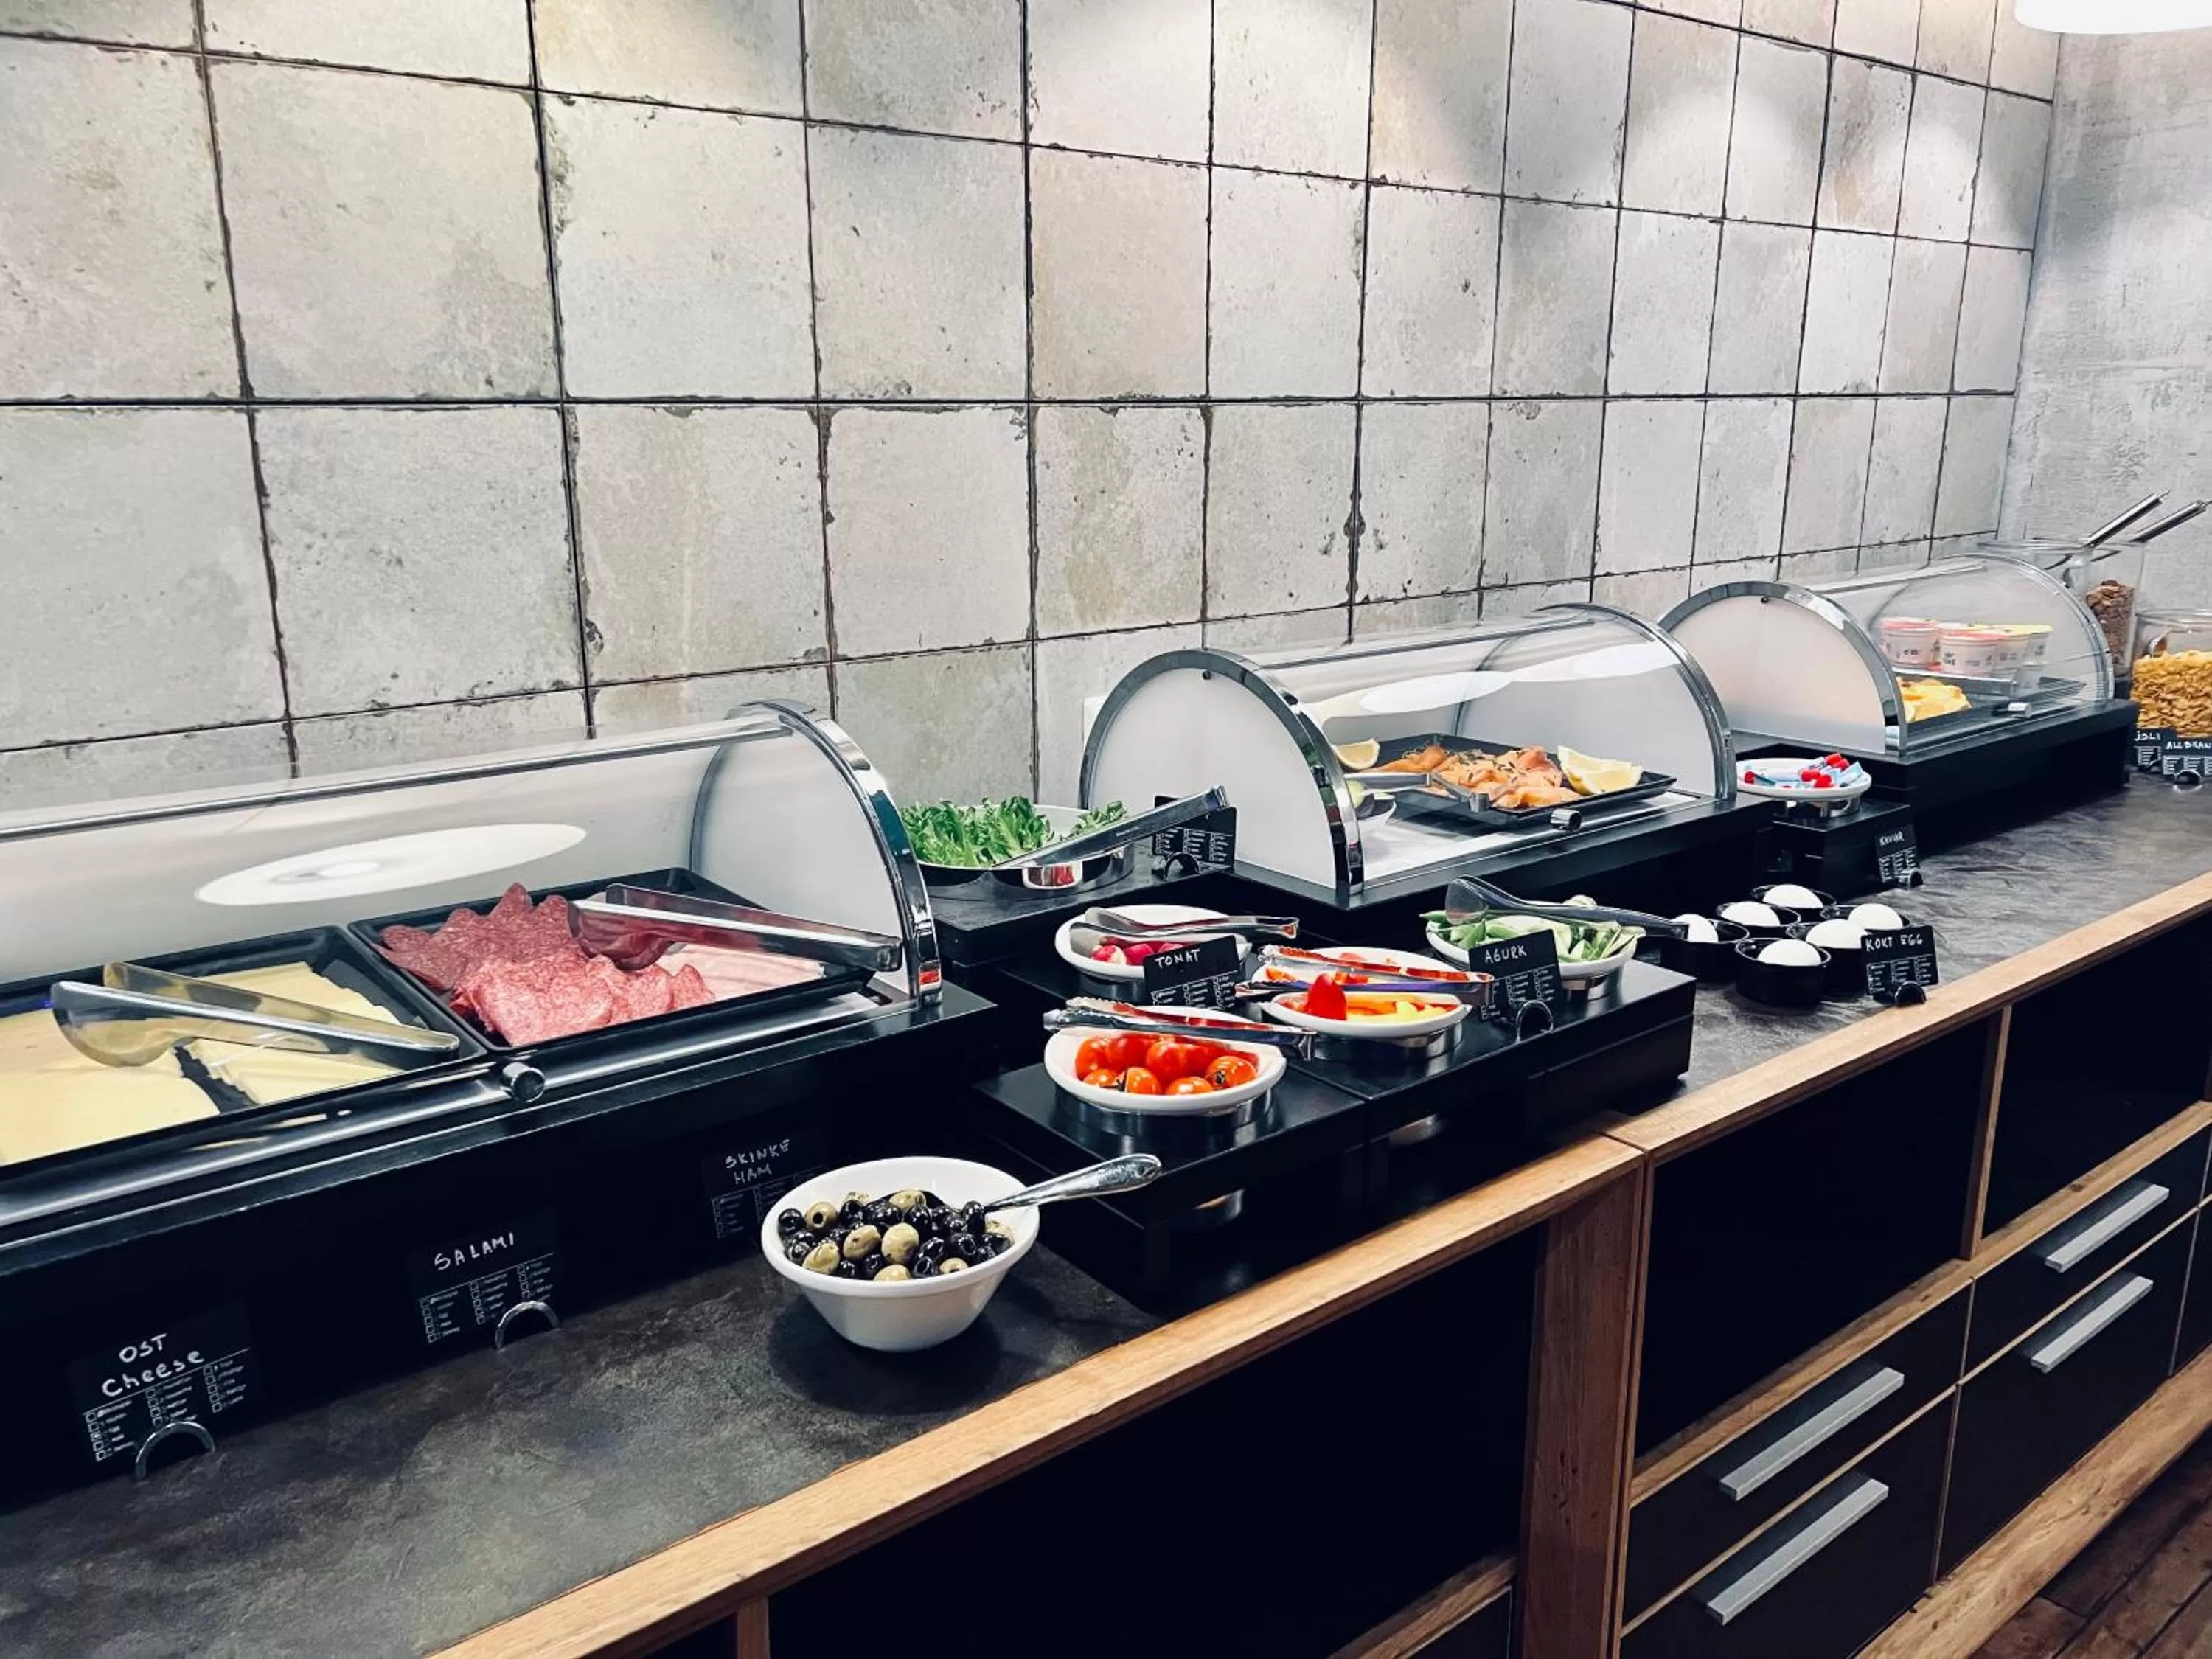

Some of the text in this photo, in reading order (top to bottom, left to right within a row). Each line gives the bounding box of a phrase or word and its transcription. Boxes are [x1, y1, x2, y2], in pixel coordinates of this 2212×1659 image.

[1484, 945, 1527, 964] AGURK
[1865, 934, 1923, 952] KOKT EGG
[1155, 948, 1200, 968] TOMAT
[725, 1138, 790, 1169] SKINKE
[734, 1162, 772, 1185] HAM
[434, 1231, 515, 1271] SALAMI
[118, 1332, 167, 1363] OST
[101, 1350, 205, 1397] Cheese
